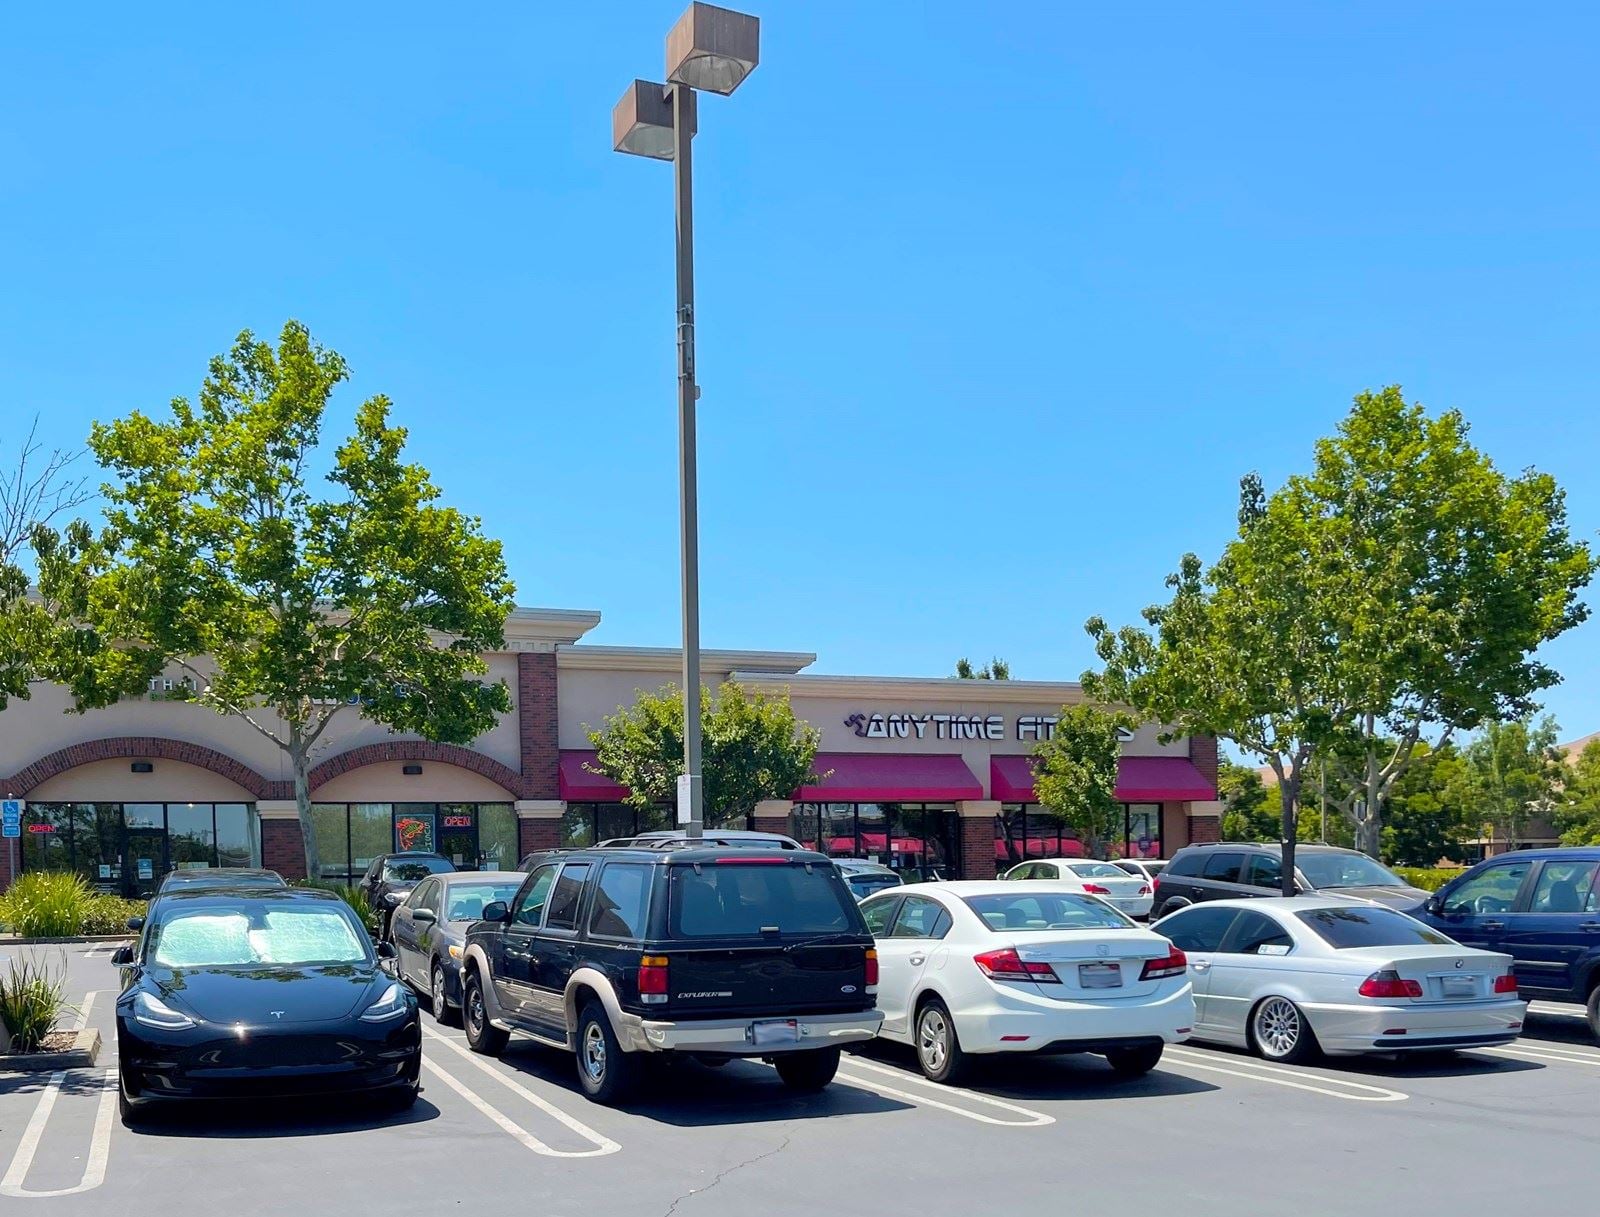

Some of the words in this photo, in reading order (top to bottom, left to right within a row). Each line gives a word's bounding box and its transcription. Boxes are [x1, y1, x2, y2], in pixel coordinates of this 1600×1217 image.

[149, 679, 197, 690] THI
[866, 714, 1004, 739] ANYTIME
[1017, 716, 1135, 742] FITS
[443, 817, 471, 826] OPEN
